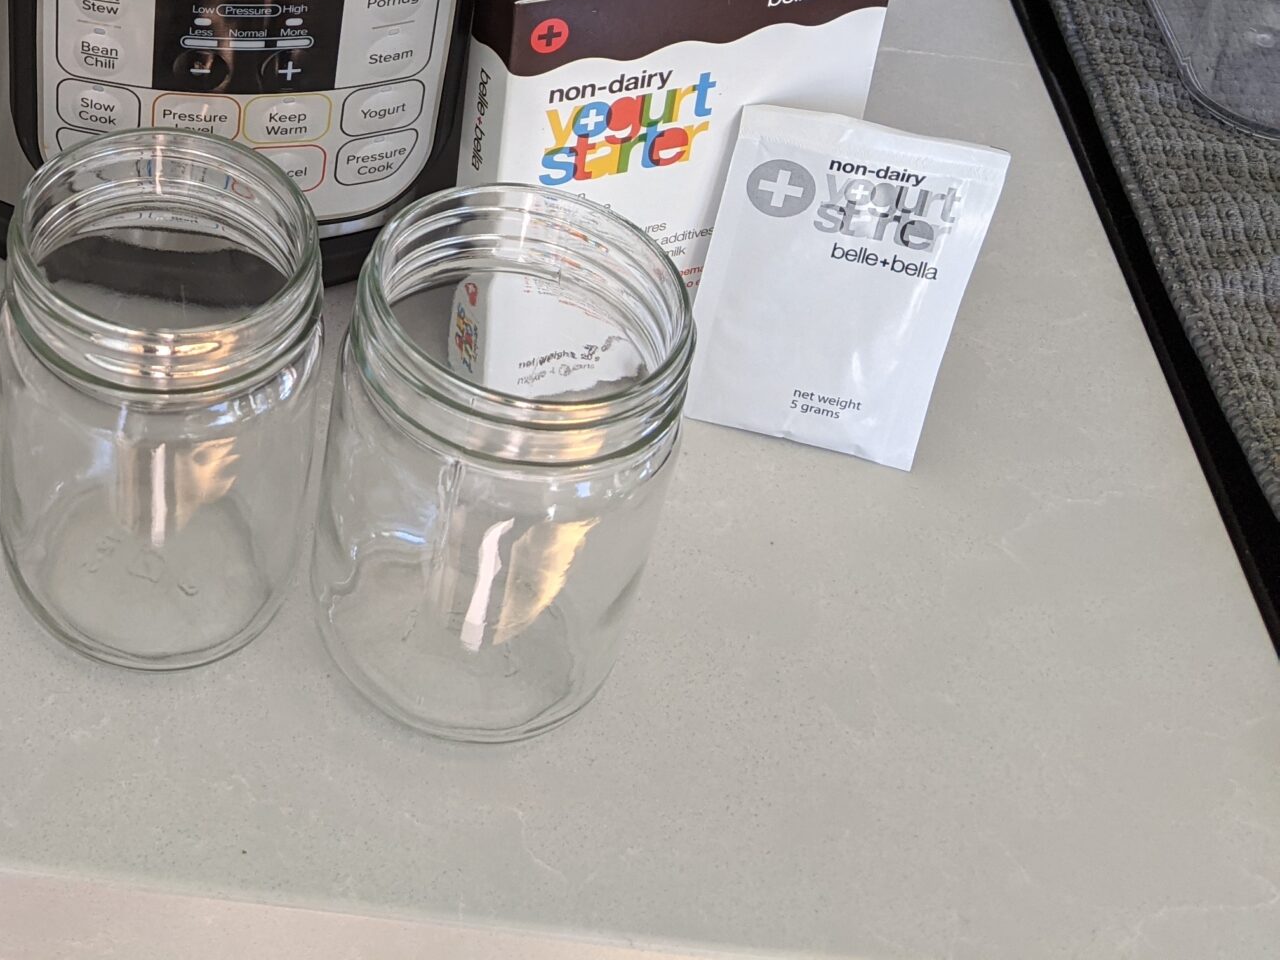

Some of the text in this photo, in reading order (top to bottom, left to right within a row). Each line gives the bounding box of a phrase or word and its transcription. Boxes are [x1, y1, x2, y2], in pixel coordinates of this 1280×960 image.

[81, 0, 120, 15] Stew
[192, 4, 309, 16] Low Pressure High
[189, 27, 309, 38] Less Normal More
[80, 40, 120, 57] Bean
[367, 48, 415, 65] Steam
[83, 55, 116, 70] Chili
[548, 69, 673, 104] non-dairy
[80, 97, 116, 113] Slow
[360, 102, 407, 121] Yogurt
[78, 110, 117, 126] Cook
[162, 109, 228, 124] Pressure
[269, 111, 308, 127] Keep
[544, 72, 717, 155] yogurt
[265, 124, 308, 136] Warm
[346, 145, 407, 165] Pressure
[357, 161, 395, 177] Cook
[828, 158, 927, 187] non-dairy
[830, 242, 938, 280] belle+bella
[793, 388, 862, 411] net weight
[790, 399, 841, 419] 5 grams
